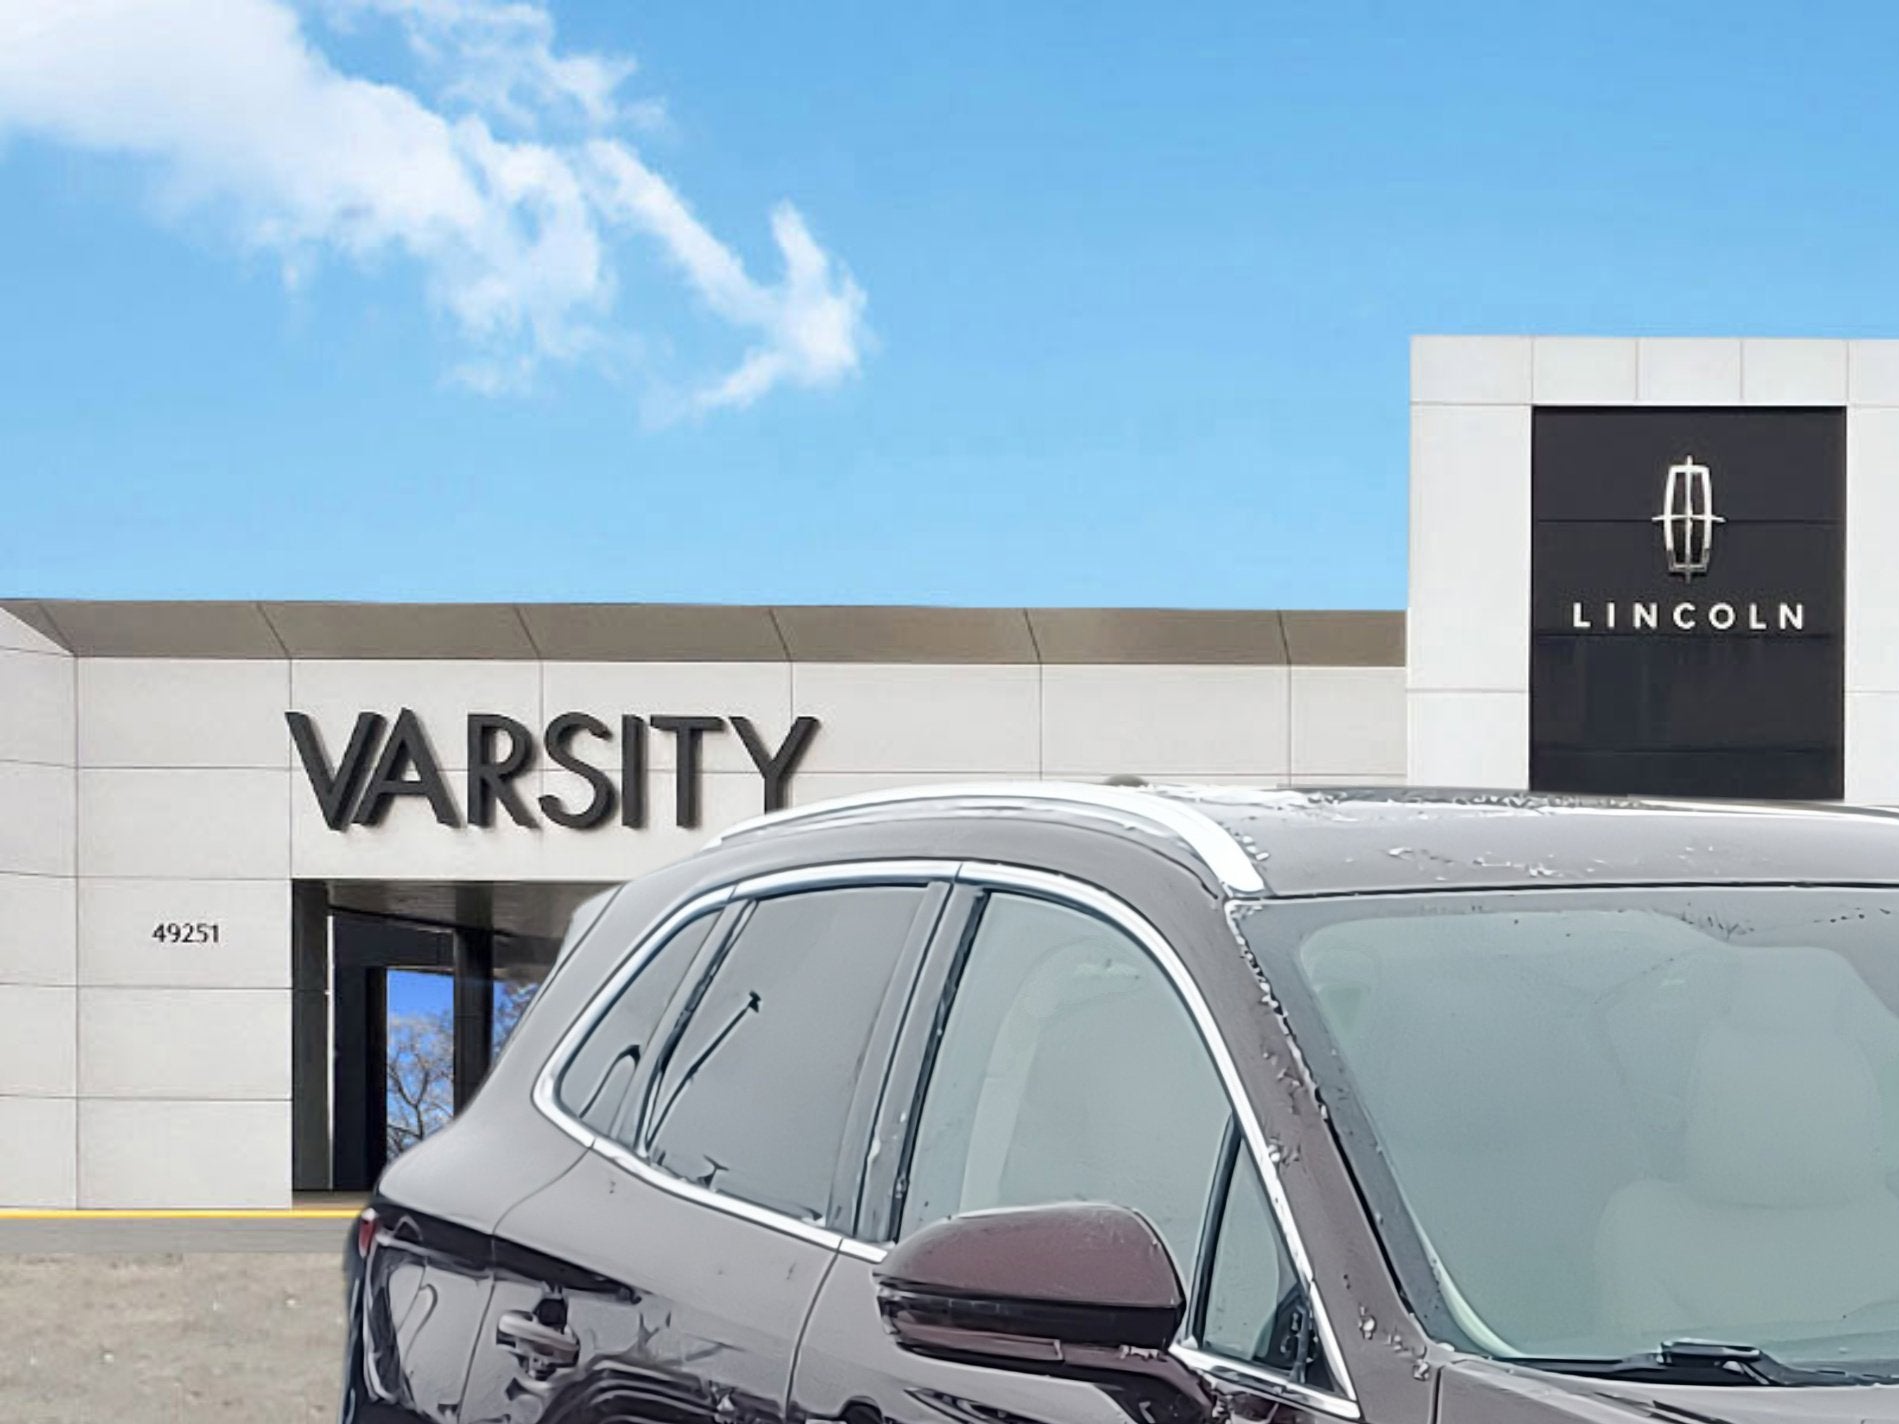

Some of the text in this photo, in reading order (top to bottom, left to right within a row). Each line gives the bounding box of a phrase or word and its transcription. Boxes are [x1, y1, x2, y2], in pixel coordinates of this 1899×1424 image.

[1572, 602, 1804, 630] LINCOLN
[284, 708, 821, 832] VARSITY
[152, 922, 219, 943] 49251
